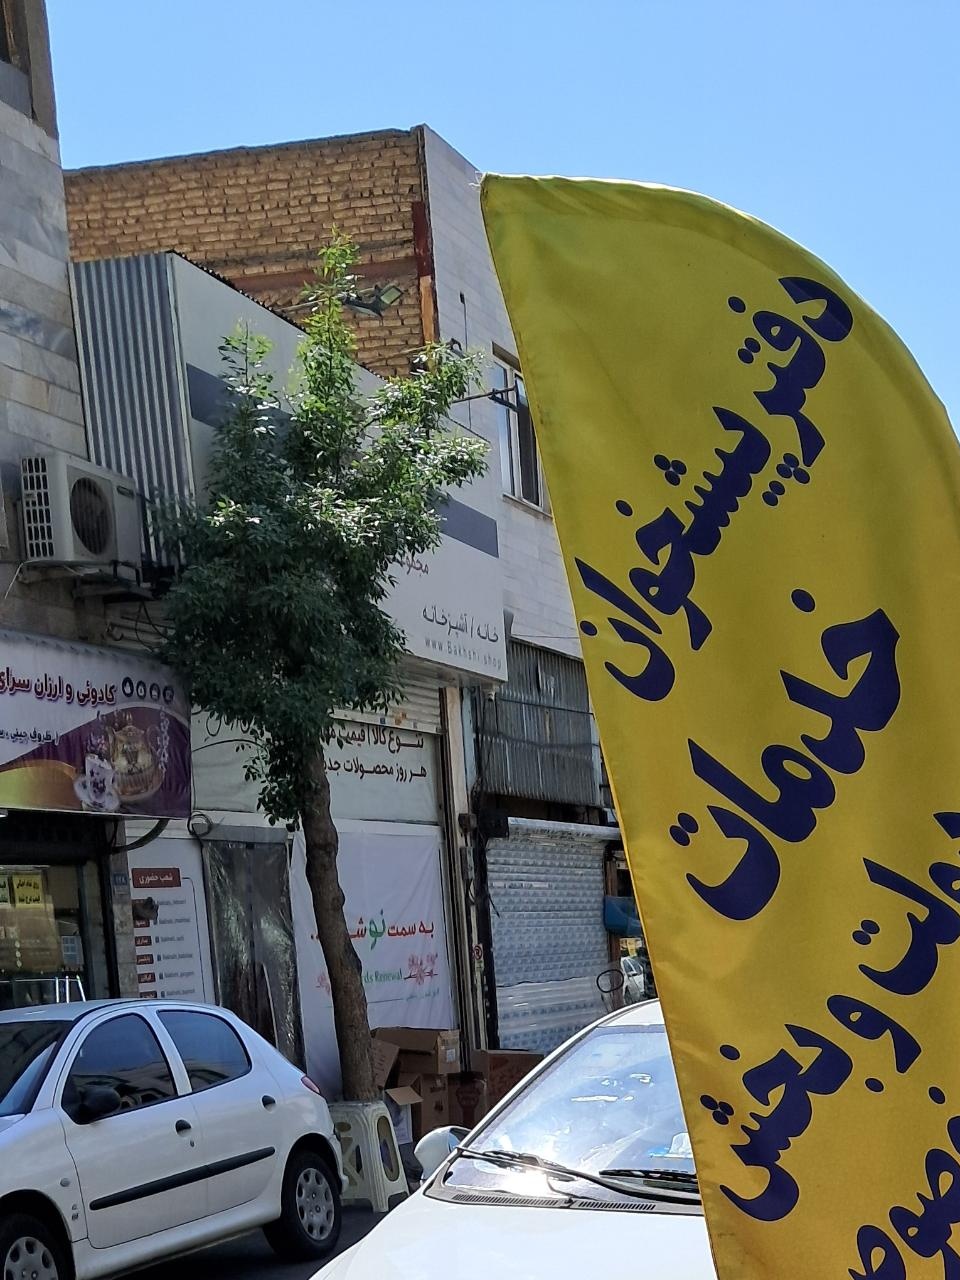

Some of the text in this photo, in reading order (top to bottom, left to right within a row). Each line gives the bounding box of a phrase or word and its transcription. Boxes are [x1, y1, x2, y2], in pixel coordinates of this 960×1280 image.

[574, 276, 854, 702] دفتر پیشخوان
[423, 604, 468, 639] آشپزخانه
[477, 623, 499, 642] خانه
[34, 673, 63, 700] ارزان
[65, 683, 74, 703] و
[668, 588, 901, 921] خدمات
[343, 756, 394, 779] محصولات
[395, 762, 407, 782] روز
[408, 765, 427, 783] هر
[387, 921, 416, 938] سمت
[418, 920, 434, 938] به
[826, 994, 922, 1074] و
[699, 1023, 885, 1222] بخش
